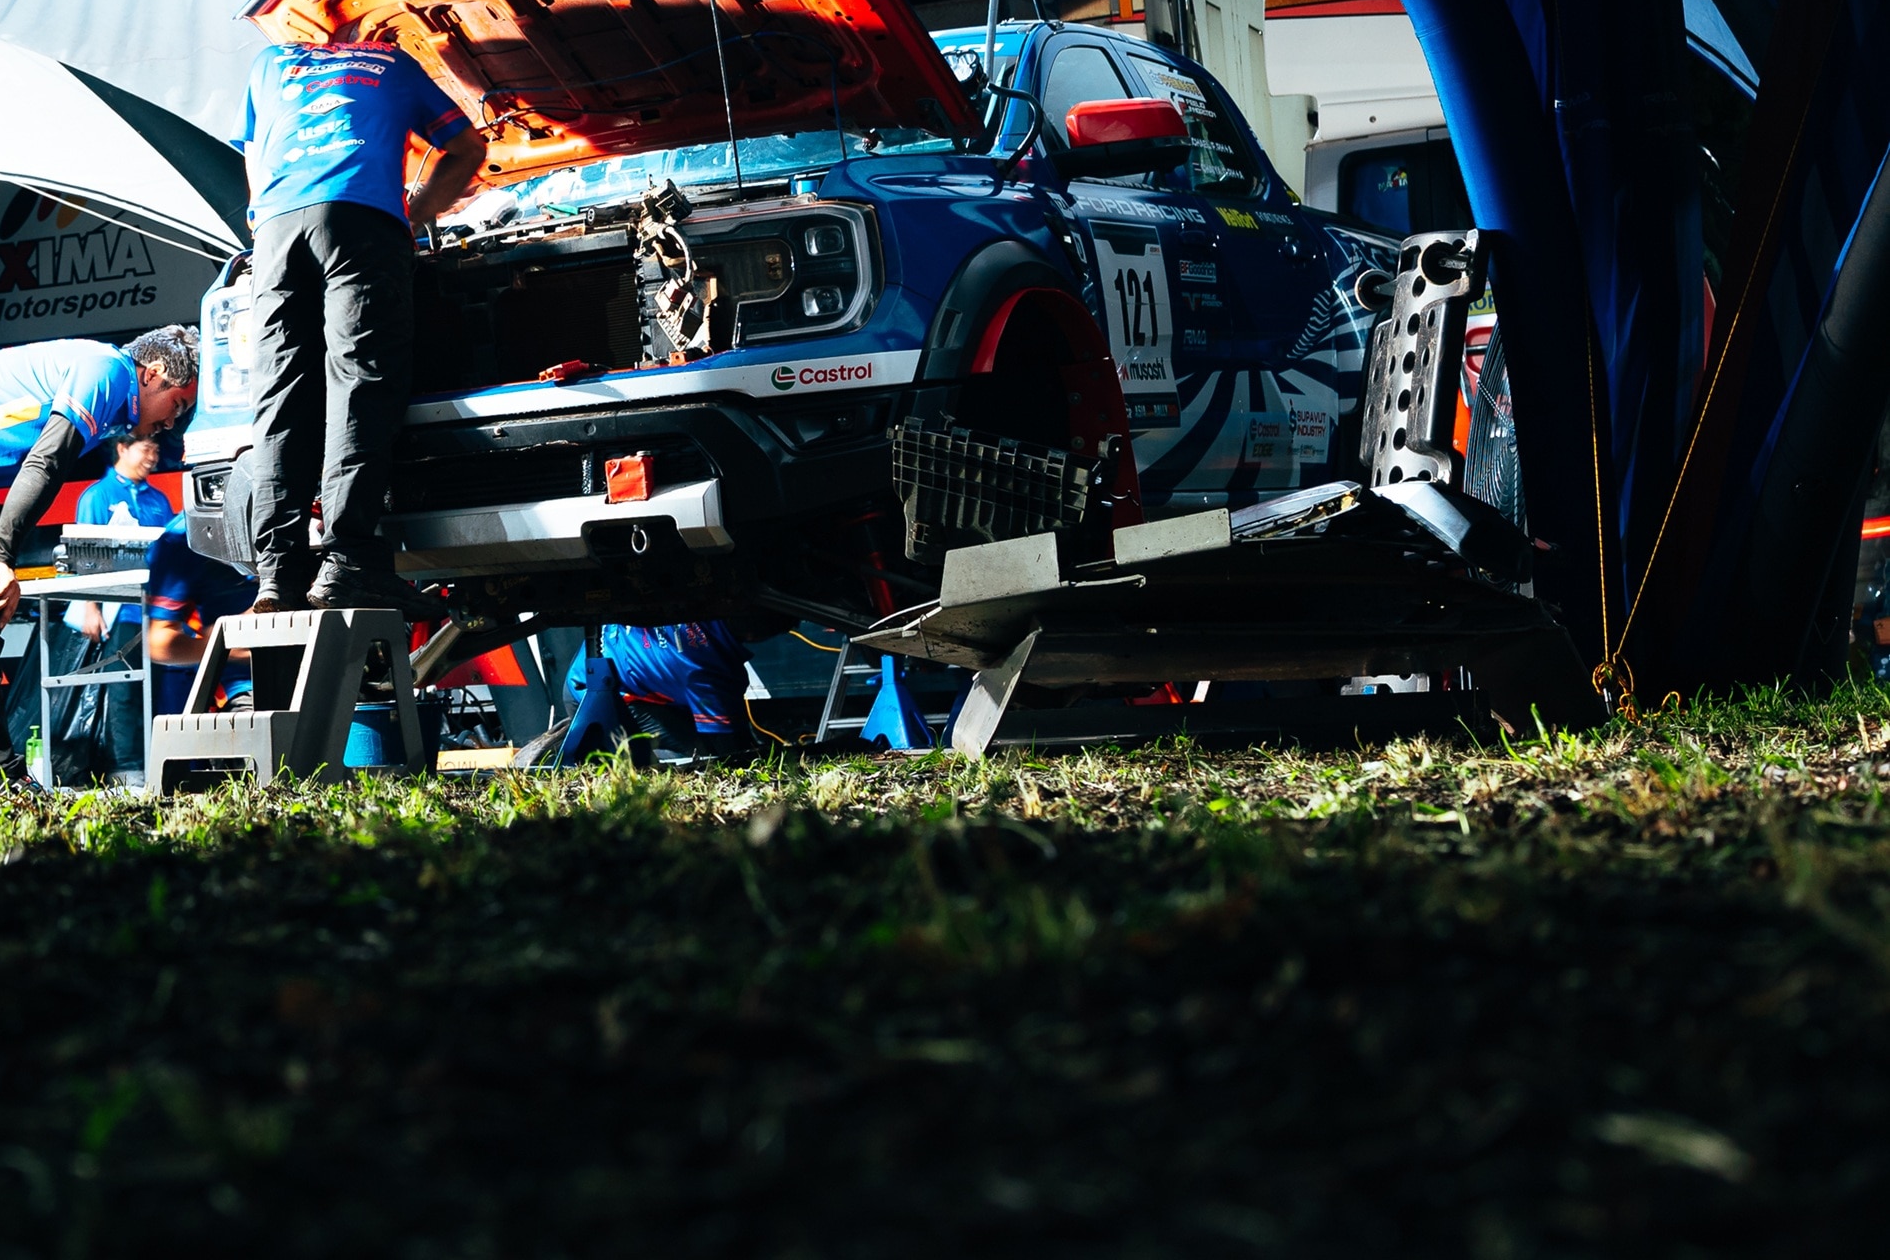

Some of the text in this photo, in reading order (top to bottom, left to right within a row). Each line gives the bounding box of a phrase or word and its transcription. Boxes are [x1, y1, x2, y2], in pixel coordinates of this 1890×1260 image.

[305, 74, 381, 93] Castrol
[1130, 201, 1206, 224] RACING
[1114, 268, 1159, 347] 121
[799, 362, 872, 385] Castrol
[1297, 410, 1327, 424] SUPAVUT
[1296, 424, 1326, 438] INDUSTRY
